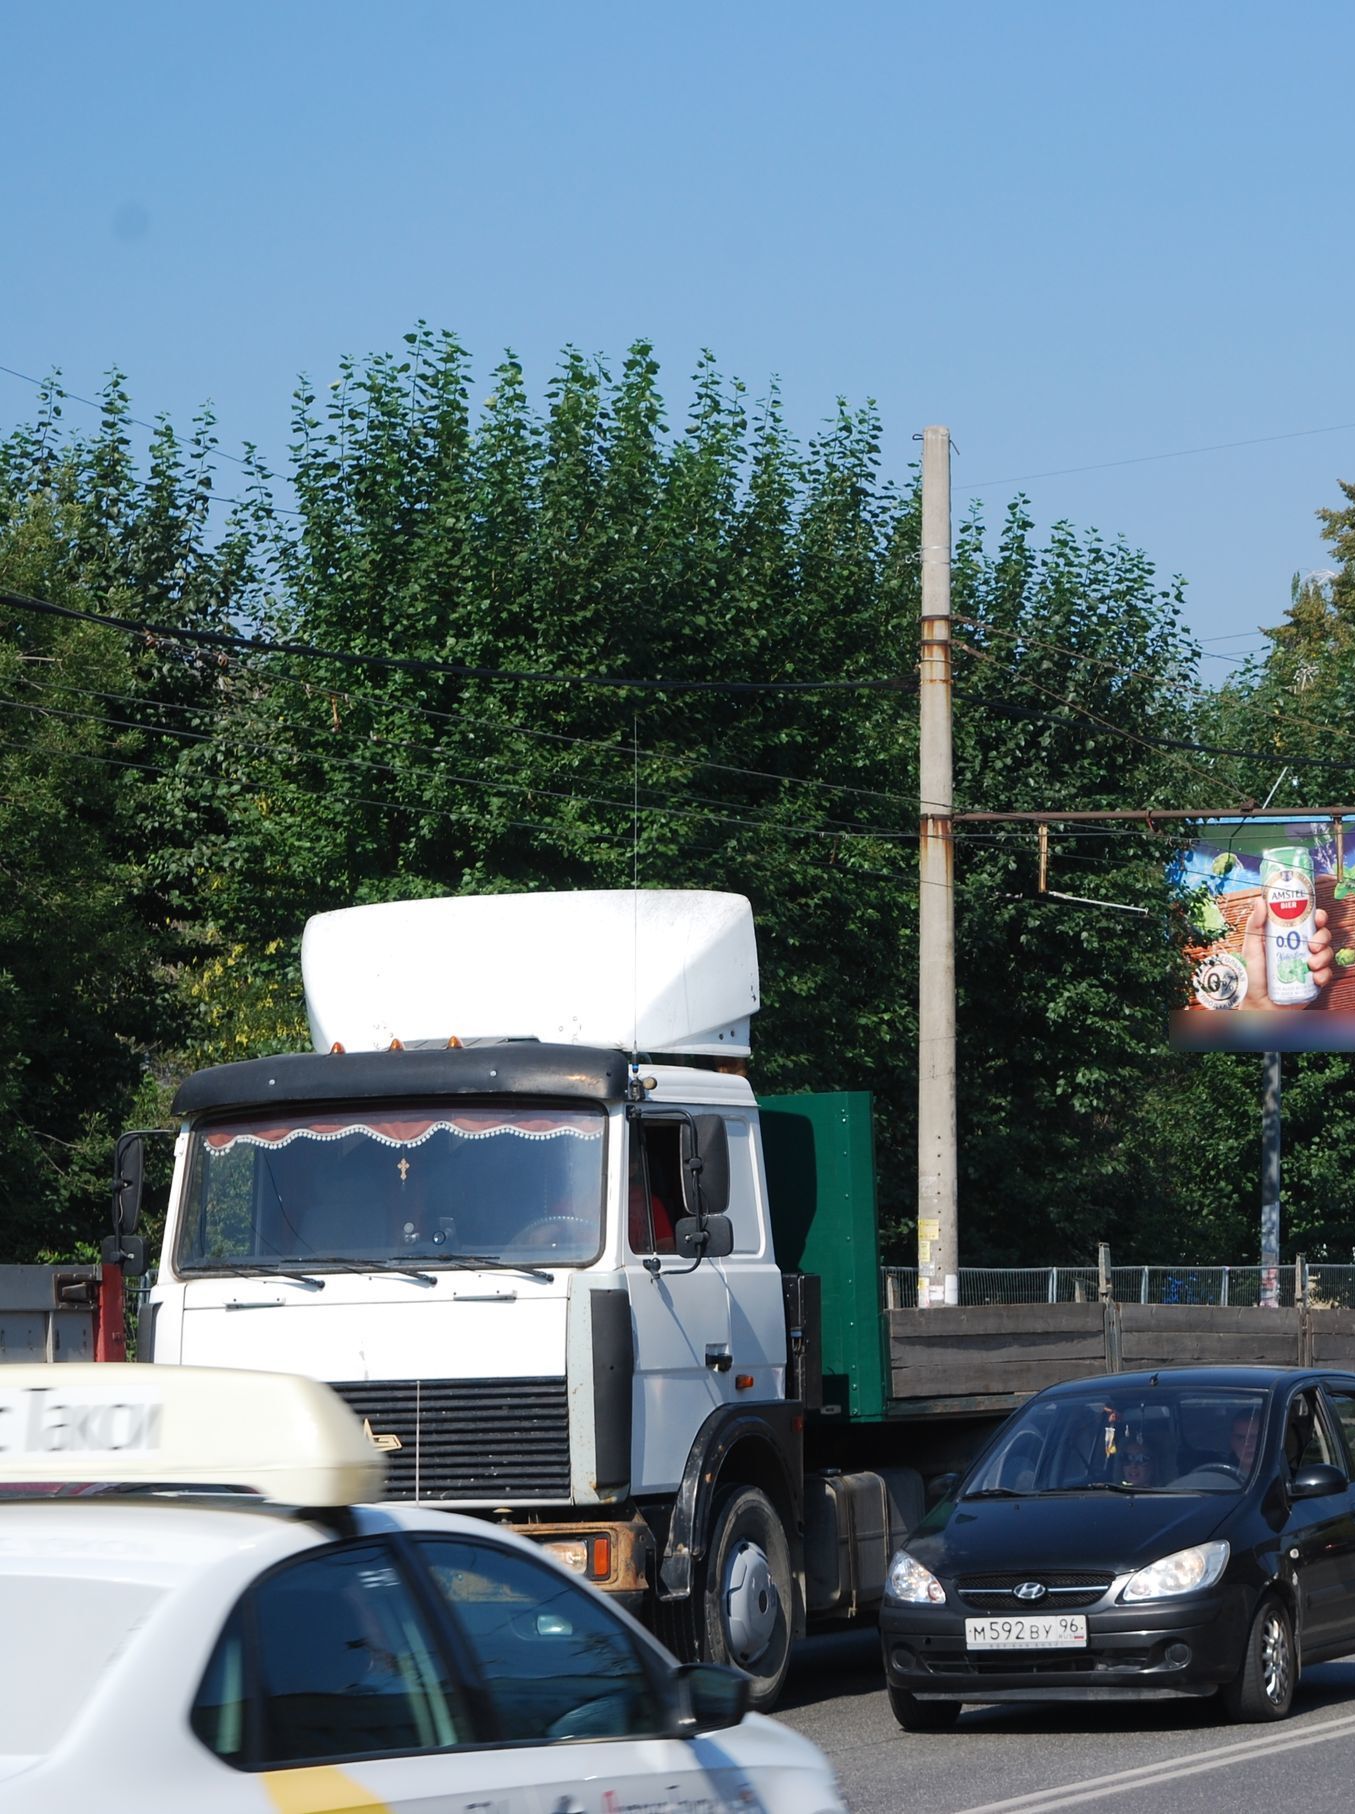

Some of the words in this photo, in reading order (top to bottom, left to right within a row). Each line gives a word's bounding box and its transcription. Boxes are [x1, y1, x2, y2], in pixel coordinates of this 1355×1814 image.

[1272, 890, 1305, 901] AMSTEL
[1280, 901, 1297, 909] BIER
[1276, 931, 1300, 950] 0.0
[973, 1621, 1052, 1641] М592ВУ
[1059, 1618, 1079, 1633] 96
